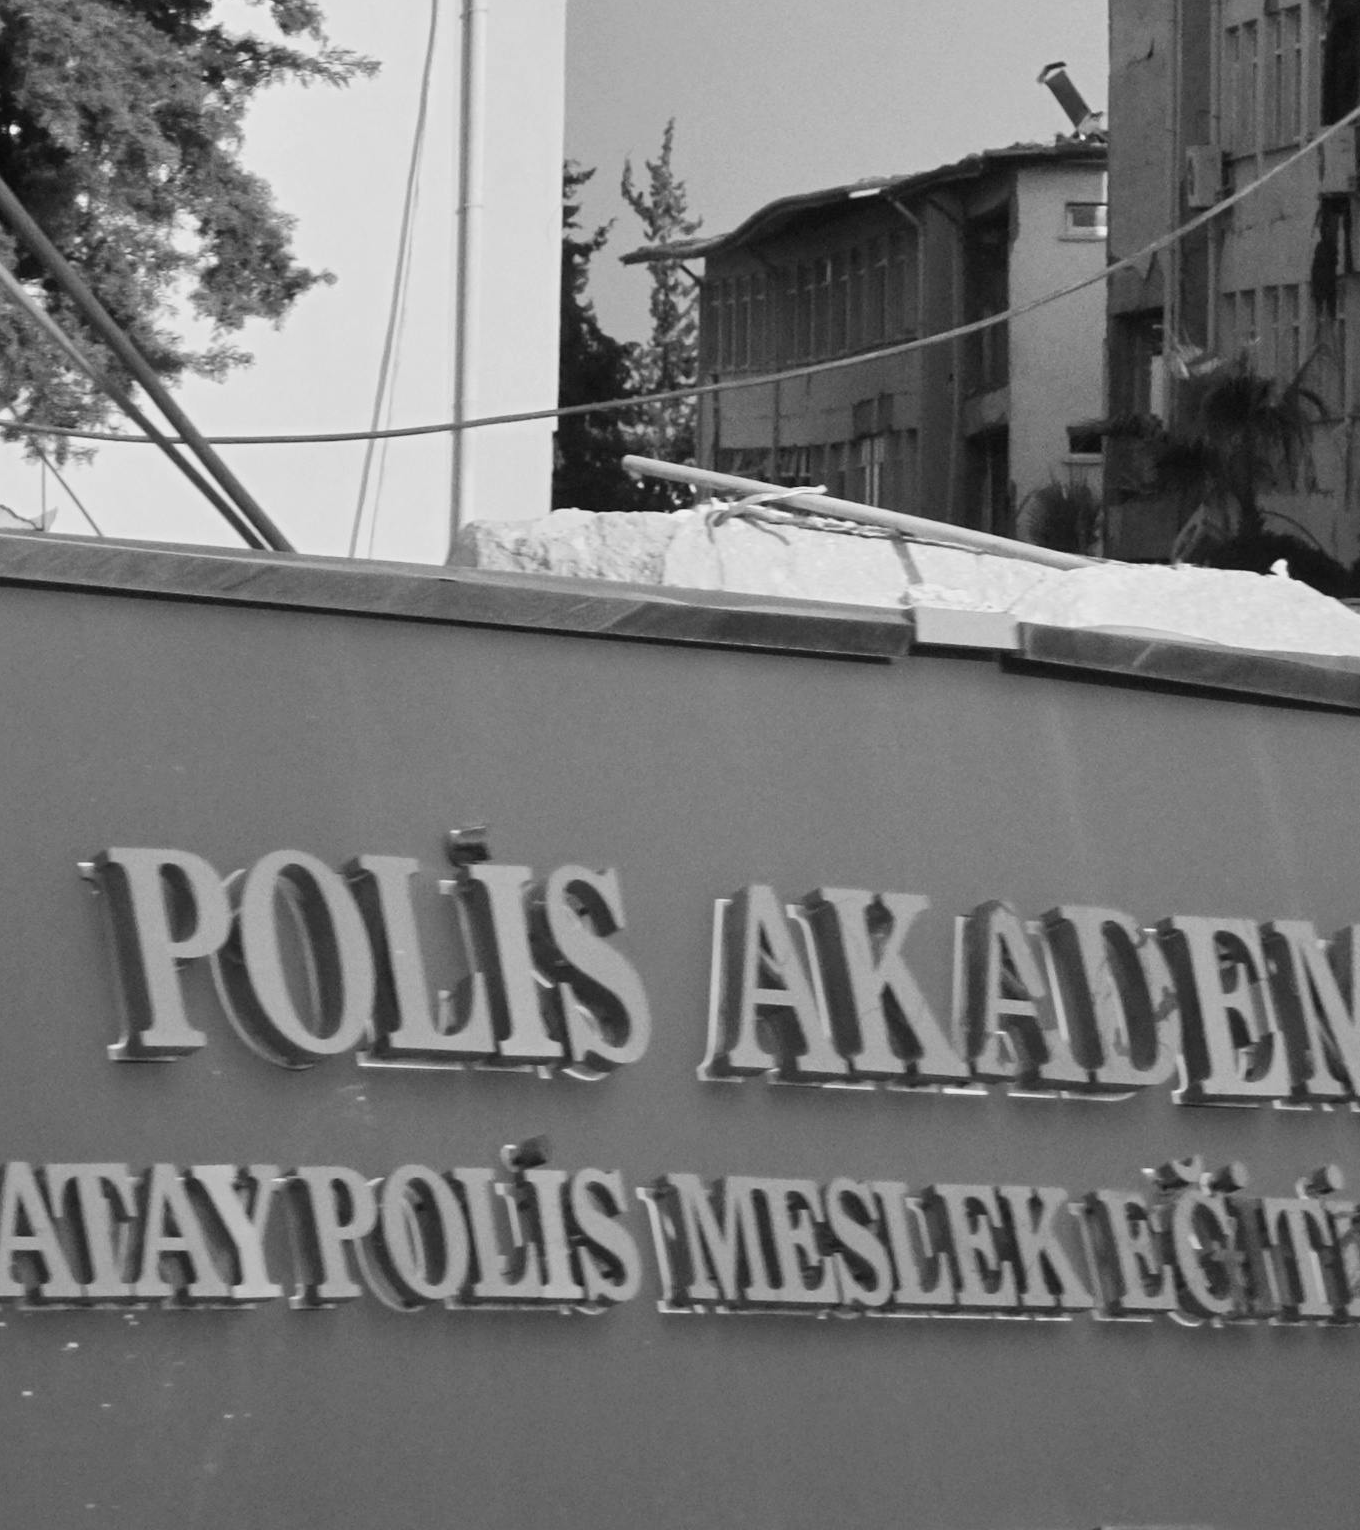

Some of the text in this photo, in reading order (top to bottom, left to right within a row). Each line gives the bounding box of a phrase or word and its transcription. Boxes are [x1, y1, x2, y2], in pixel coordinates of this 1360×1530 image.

[89, 825, 652, 1068] POLİS
[289, 1137, 640, 1305] POLİS
[649, 1173, 1095, 1312] MESLEK
